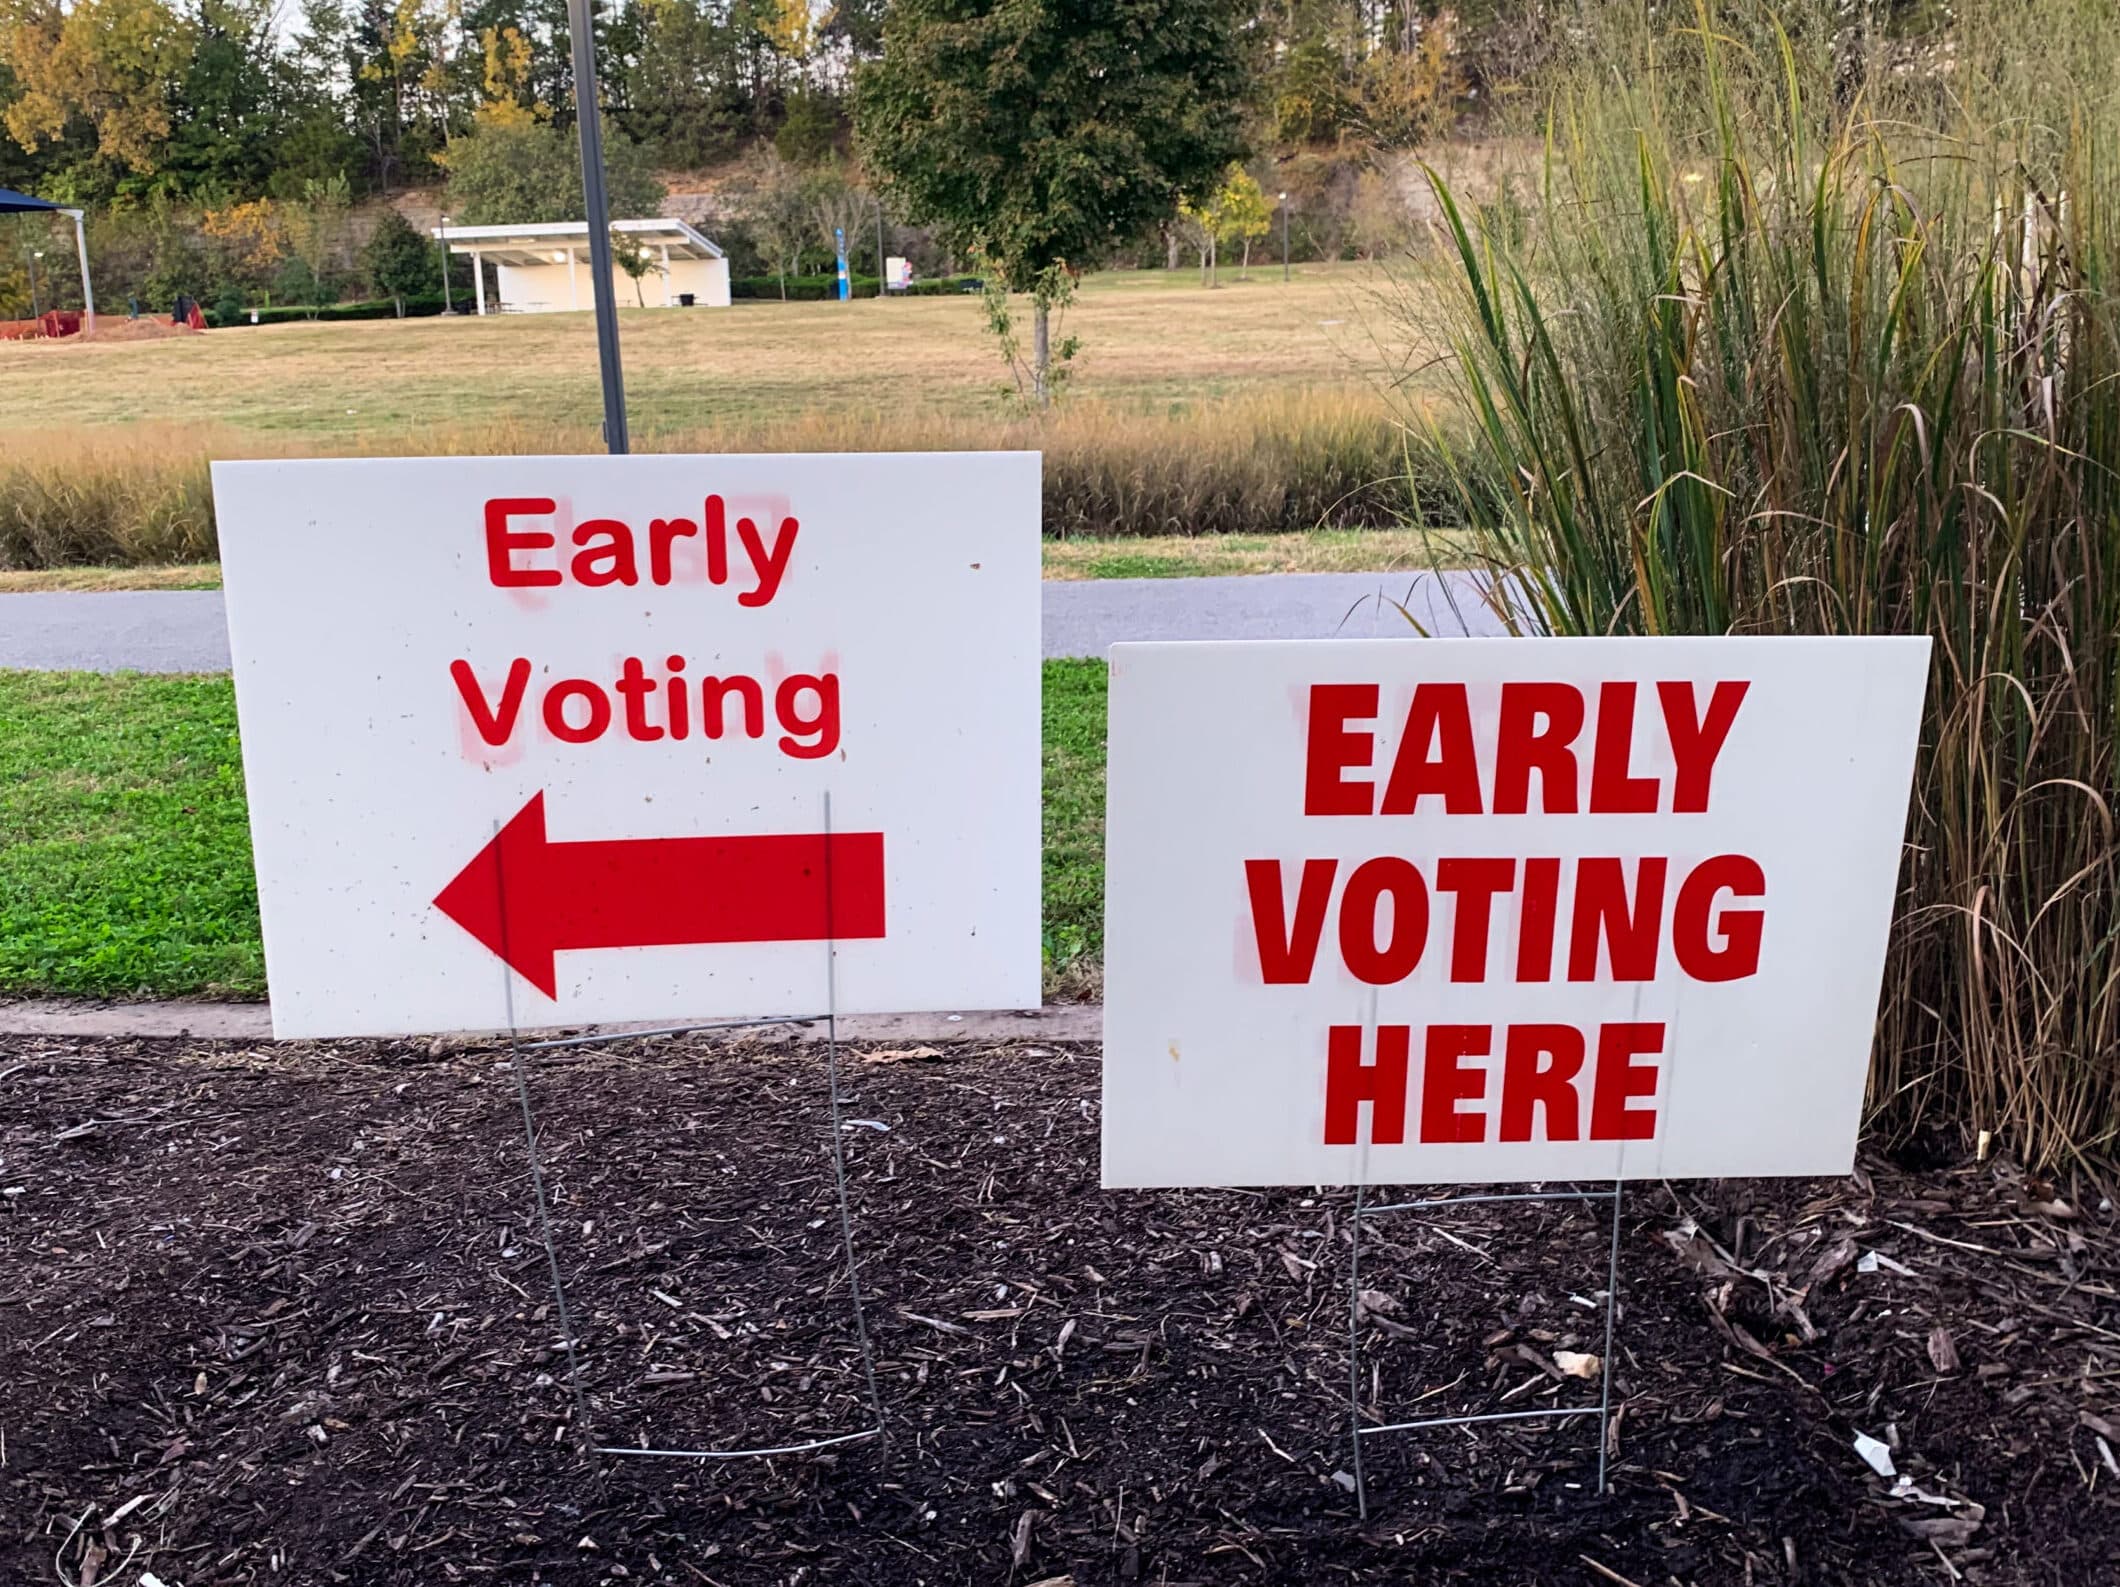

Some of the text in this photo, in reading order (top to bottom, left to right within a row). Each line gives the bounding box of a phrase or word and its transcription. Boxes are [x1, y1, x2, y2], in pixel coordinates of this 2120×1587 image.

[484, 494, 799, 608] Early
[450, 655, 842, 760] Voting
[1304, 681, 1751, 816] EARLY
[1245, 854, 1765, 985] VOTING
[1324, 1022, 1665, 1145] HERE
